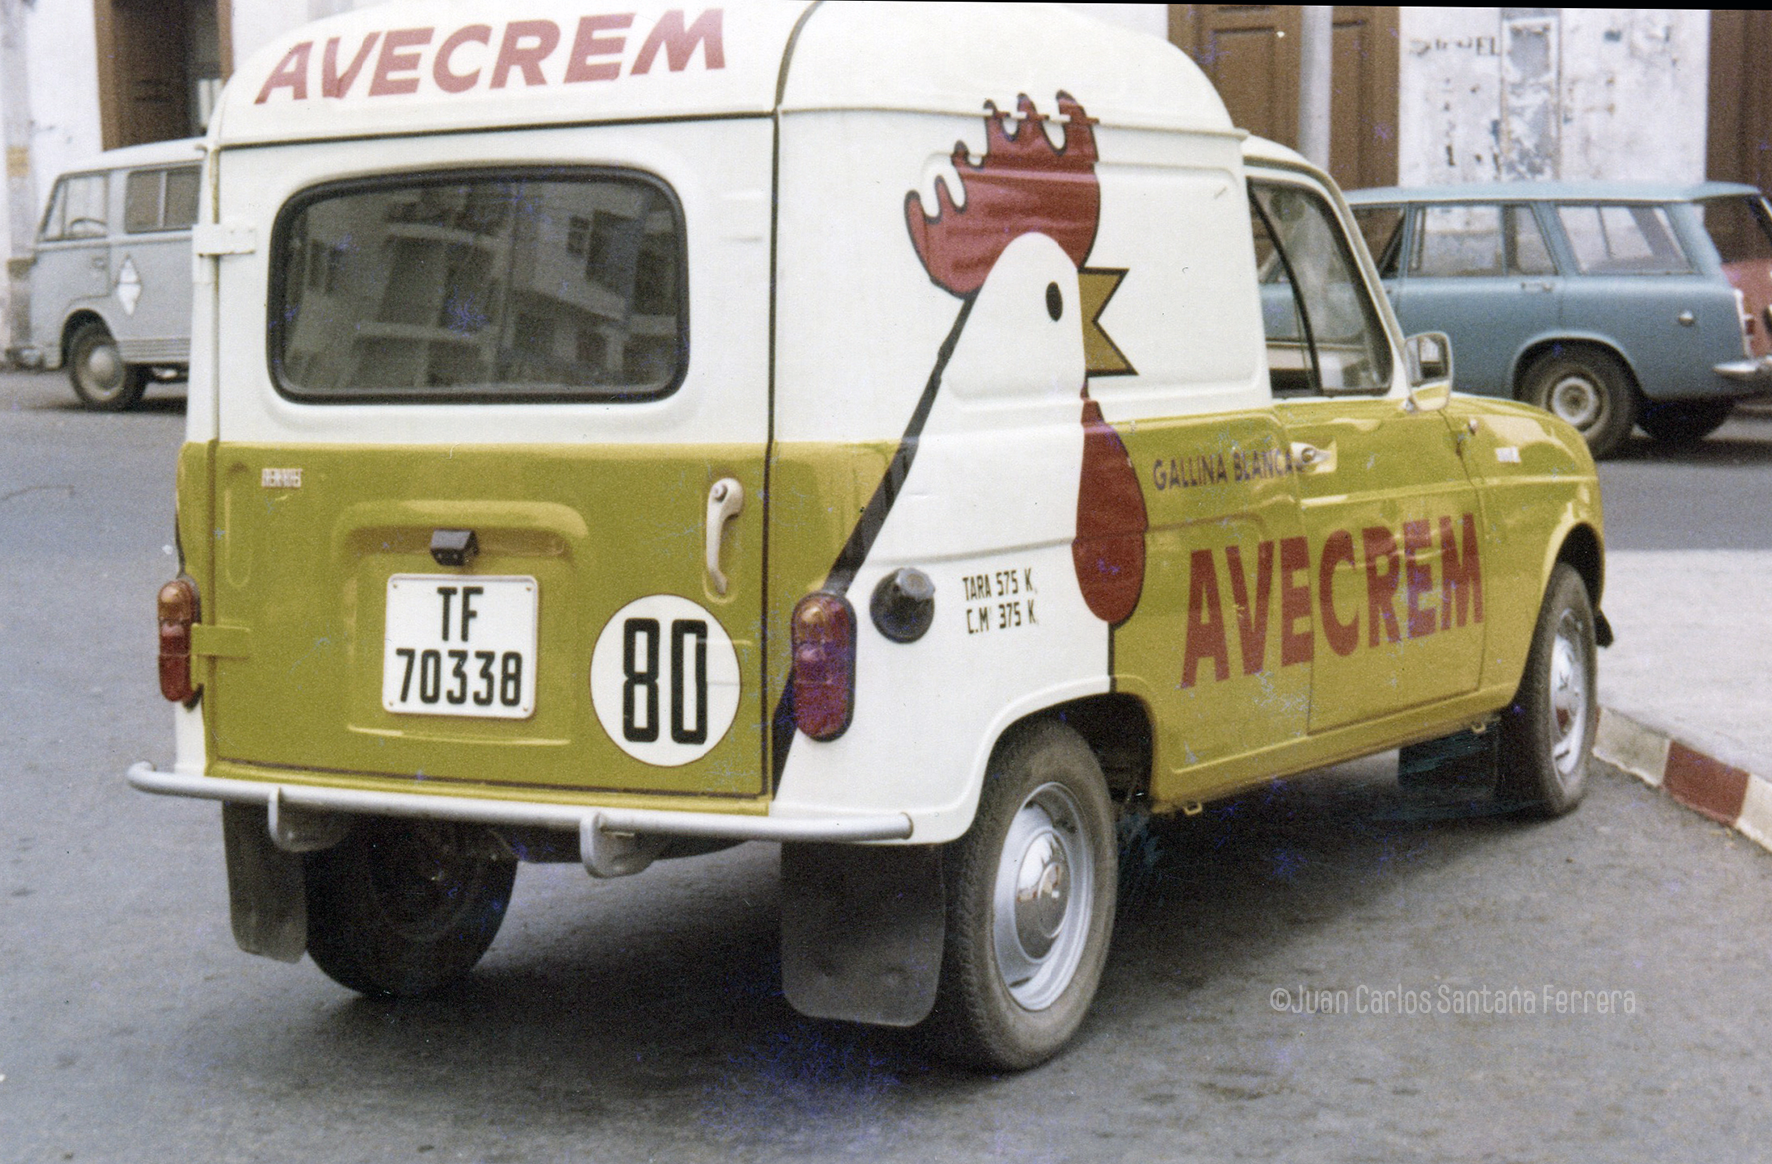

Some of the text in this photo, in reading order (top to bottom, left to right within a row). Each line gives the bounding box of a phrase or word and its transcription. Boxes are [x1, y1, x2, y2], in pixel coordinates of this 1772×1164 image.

[254, 8, 726, 104] AVECREM
[1153, 447, 1293, 490] GALLINA BLANCA
[962, 574, 992, 601] TARA
[996, 569, 1019, 596] 575
[1180, 512, 1484, 689] AVECREM
[437, 586, 484, 642] TF
[999, 601, 1022, 629] 375
[396, 648, 523, 706] 70338
[623, 617, 708, 745] 80
